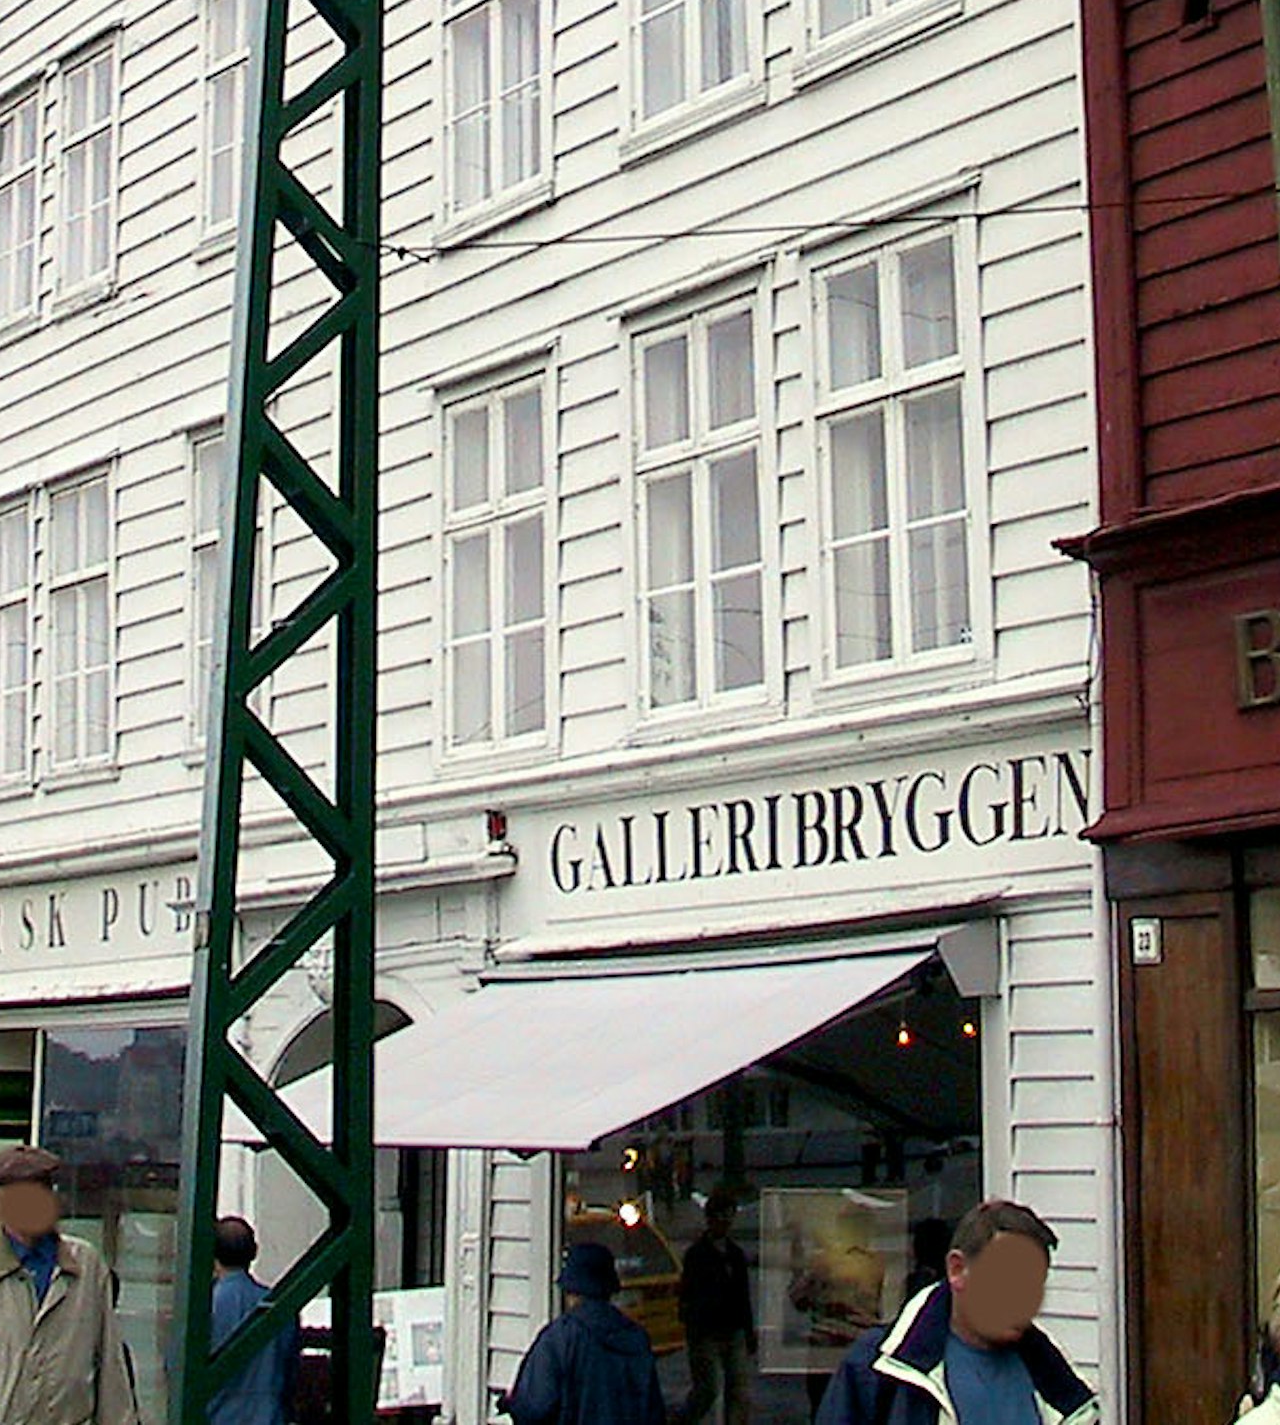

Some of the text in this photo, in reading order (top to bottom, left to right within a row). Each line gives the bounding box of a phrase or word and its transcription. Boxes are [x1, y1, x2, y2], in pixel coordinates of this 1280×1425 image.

[550, 747, 1092, 895] GALLERI BRYGGEN
[101, 876, 191, 942] PUB
